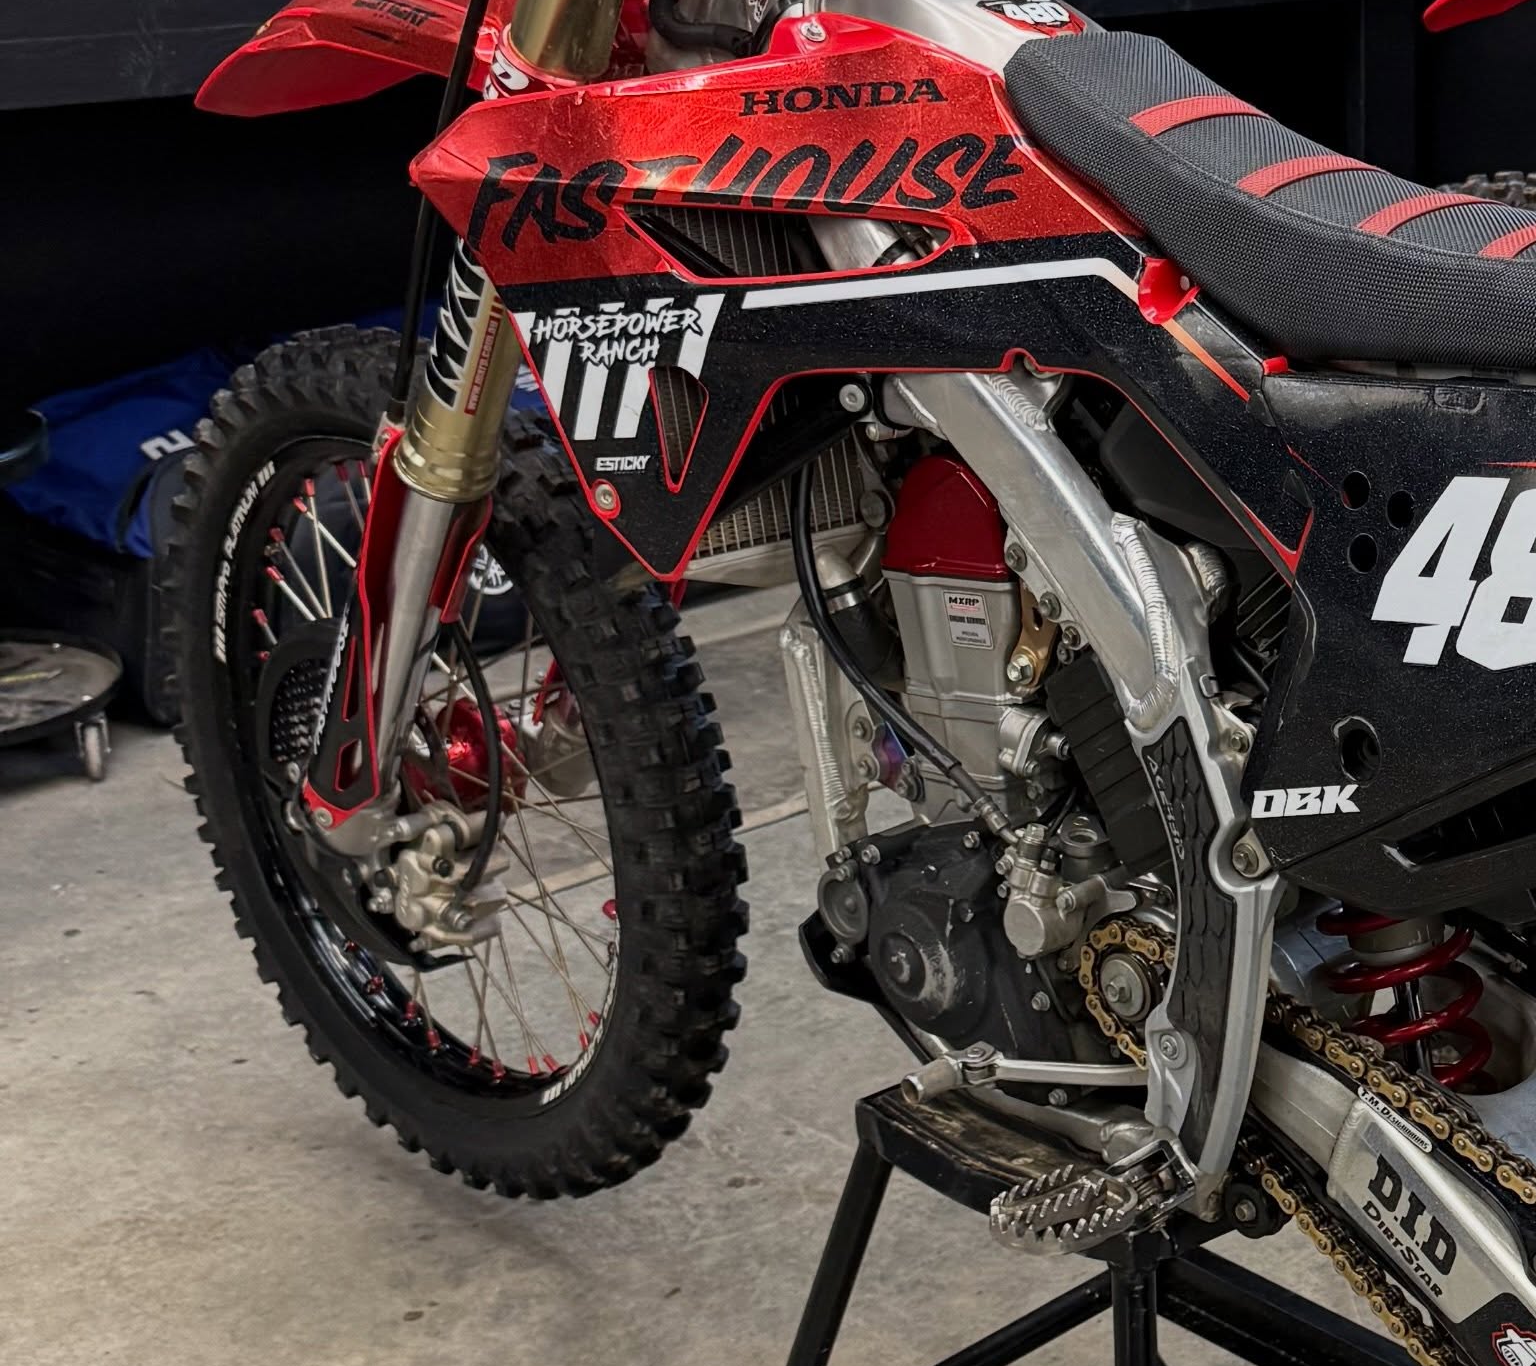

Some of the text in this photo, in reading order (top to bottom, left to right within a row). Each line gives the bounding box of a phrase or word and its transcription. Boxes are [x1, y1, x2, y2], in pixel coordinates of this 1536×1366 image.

[1003, 0, 1070, 26] 480
[739, 78, 948, 118] HONDA
[532, 307, 704, 344] HORSEPOWER
[579, 337, 660, 368] RANCH
[949, 596, 980, 606] MXRP
